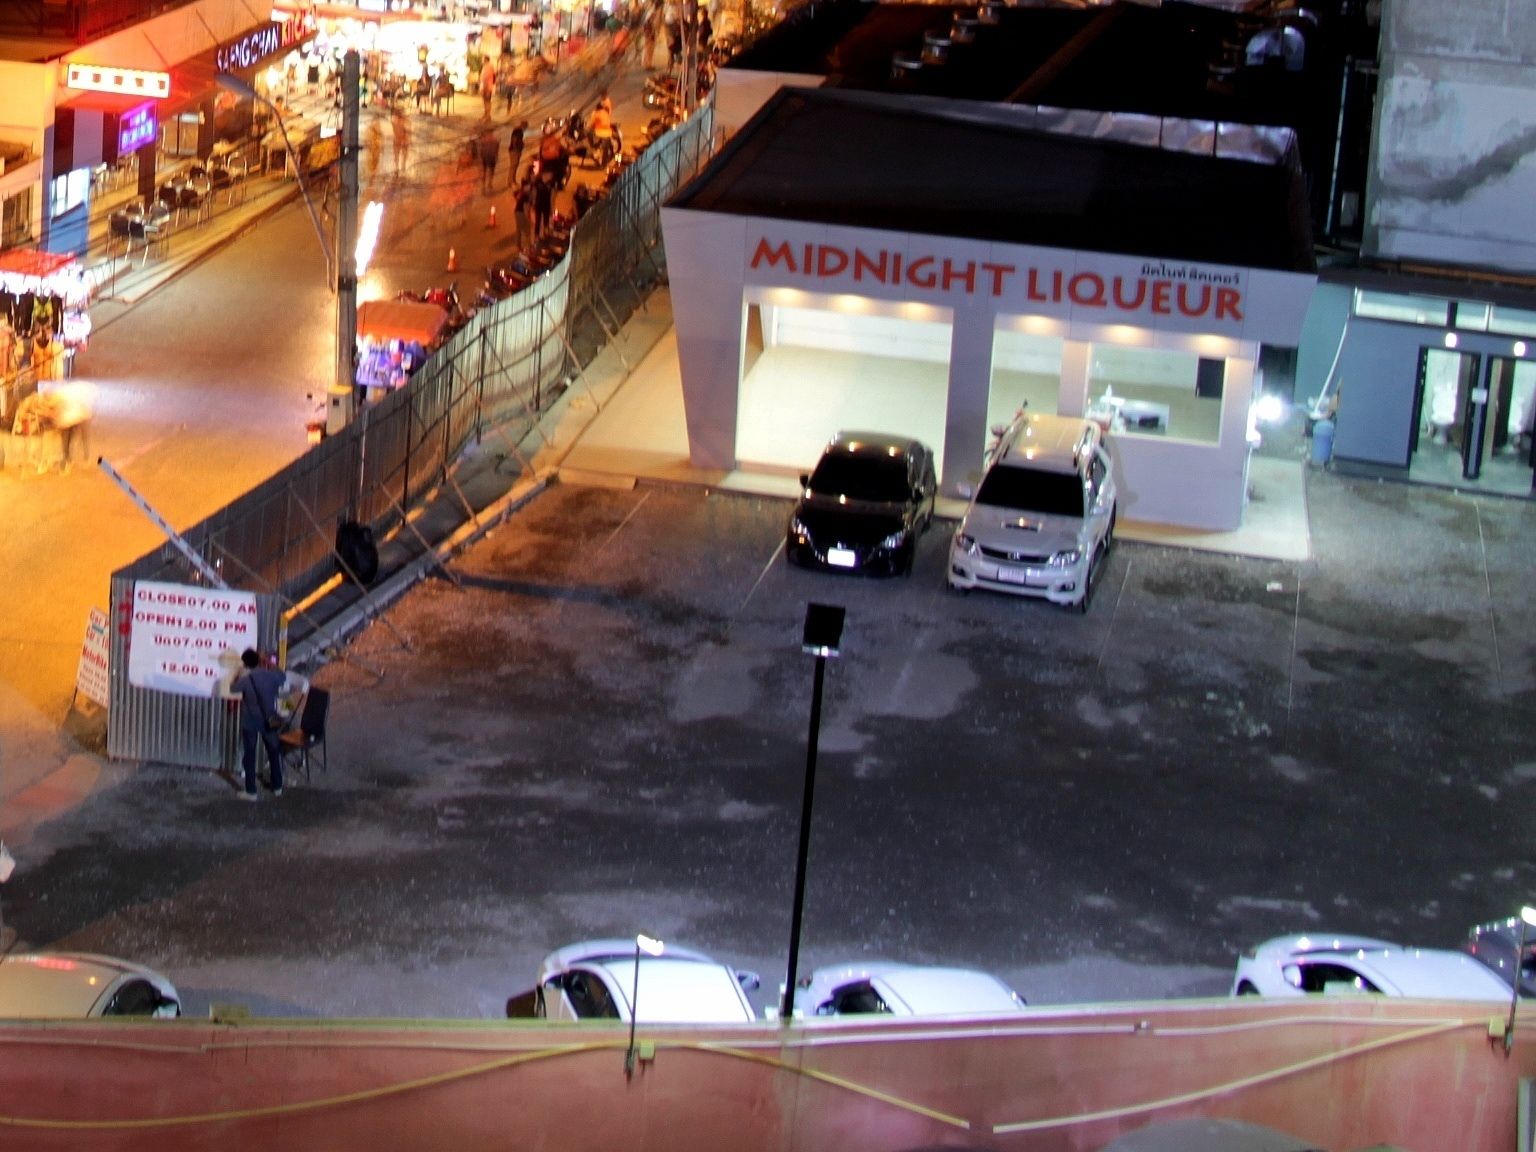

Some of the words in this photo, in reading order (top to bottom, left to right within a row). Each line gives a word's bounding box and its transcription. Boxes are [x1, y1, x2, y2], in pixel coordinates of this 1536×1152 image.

[750, 236, 1015, 297] MIDNIGHT
[1026, 267, 1243, 322] LIQUEUR
[224, 621, 247, 634] PM
